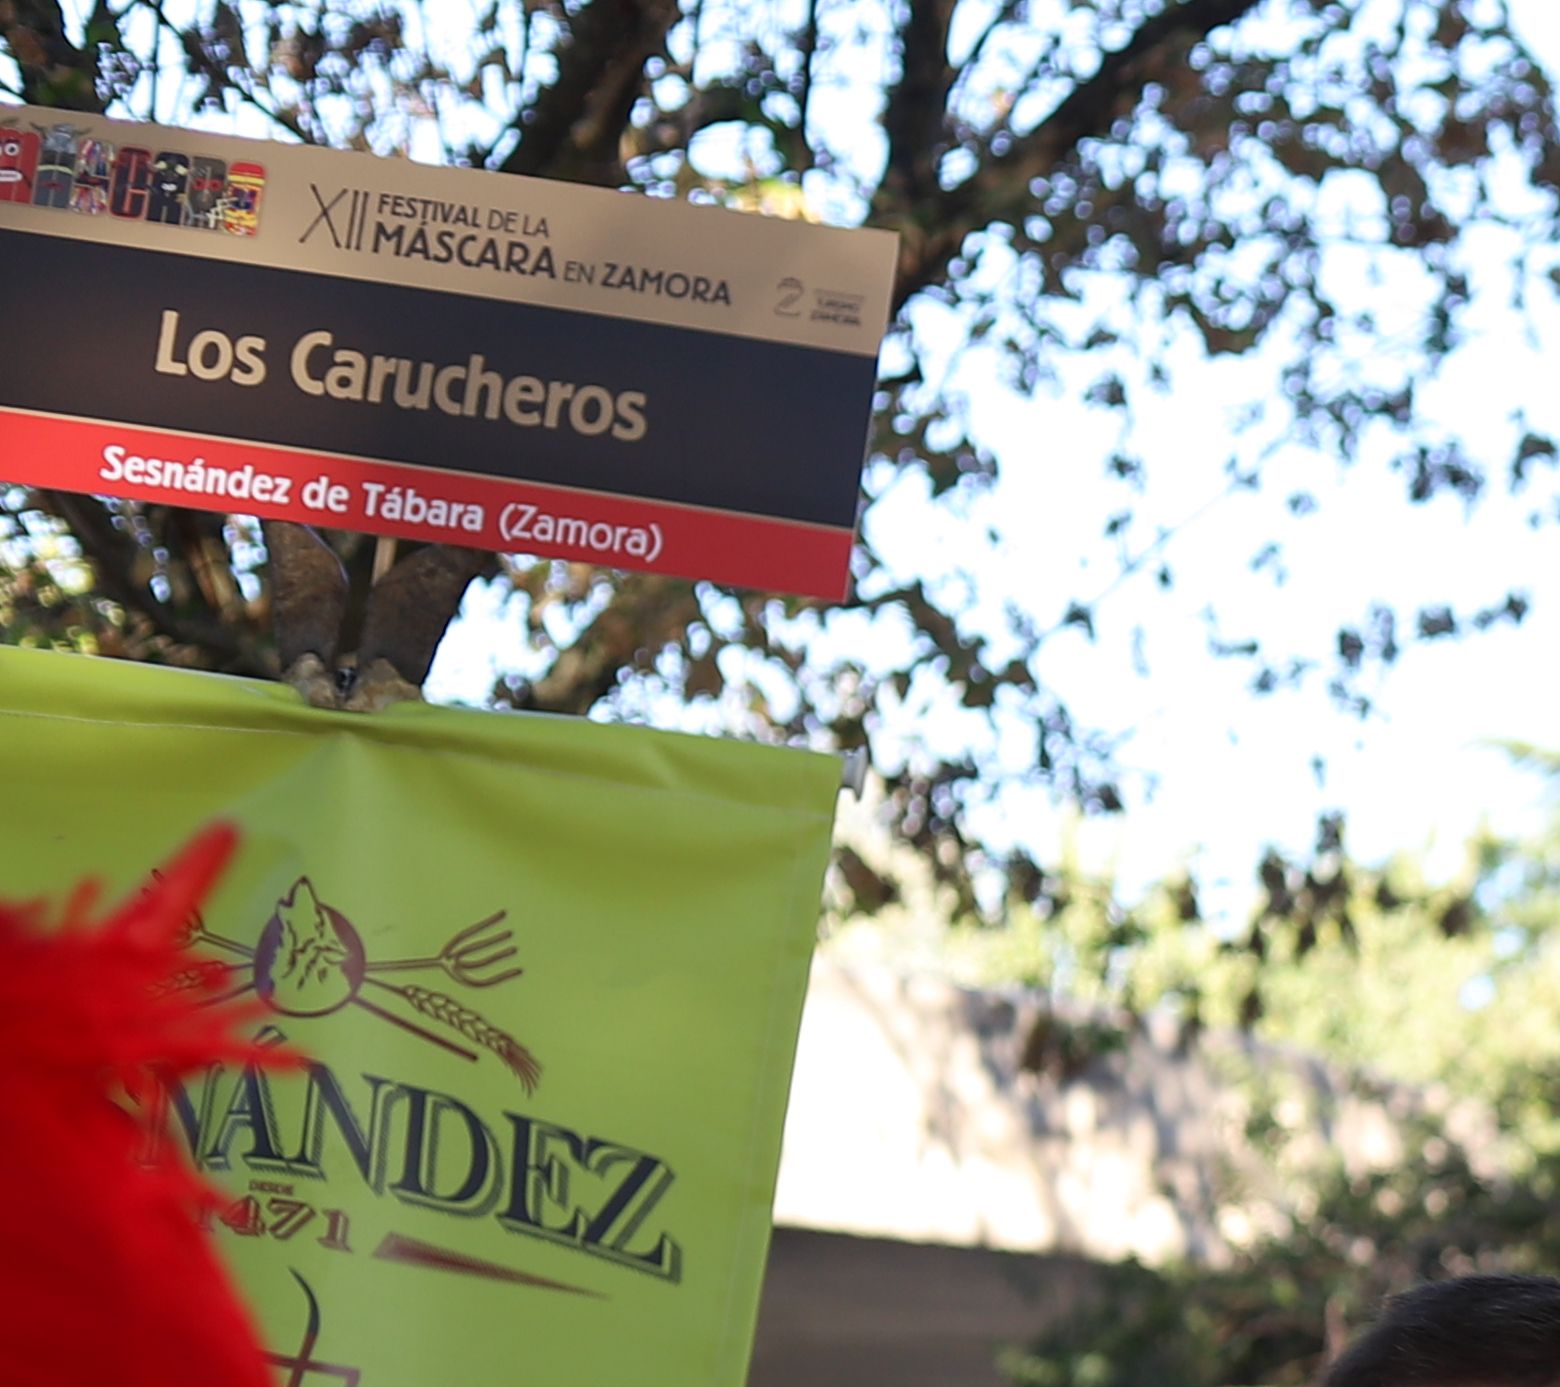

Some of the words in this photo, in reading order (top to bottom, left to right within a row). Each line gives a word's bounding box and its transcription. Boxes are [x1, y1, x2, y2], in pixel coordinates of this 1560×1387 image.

[299, 183, 370, 250] XII
[372, 221, 556, 279] MÁSCARA
[564, 261, 595, 284] EN
[601, 262, 731, 306] ZAMORA
[377, 193, 481, 229] FESTIVAL
[488, 209, 519, 232] DE
[522, 214, 549, 238] LA
[154, 310, 266, 386] Los
[290, 330, 648, 442] Carucheros
[100, 446, 290, 504] Sesnández
[302, 476, 349, 512] de
[362, 482, 484, 532] Tábara
[499, 502, 663, 563] (Zamora)
[110, 1024, 684, 1284] NÁNDEZ
